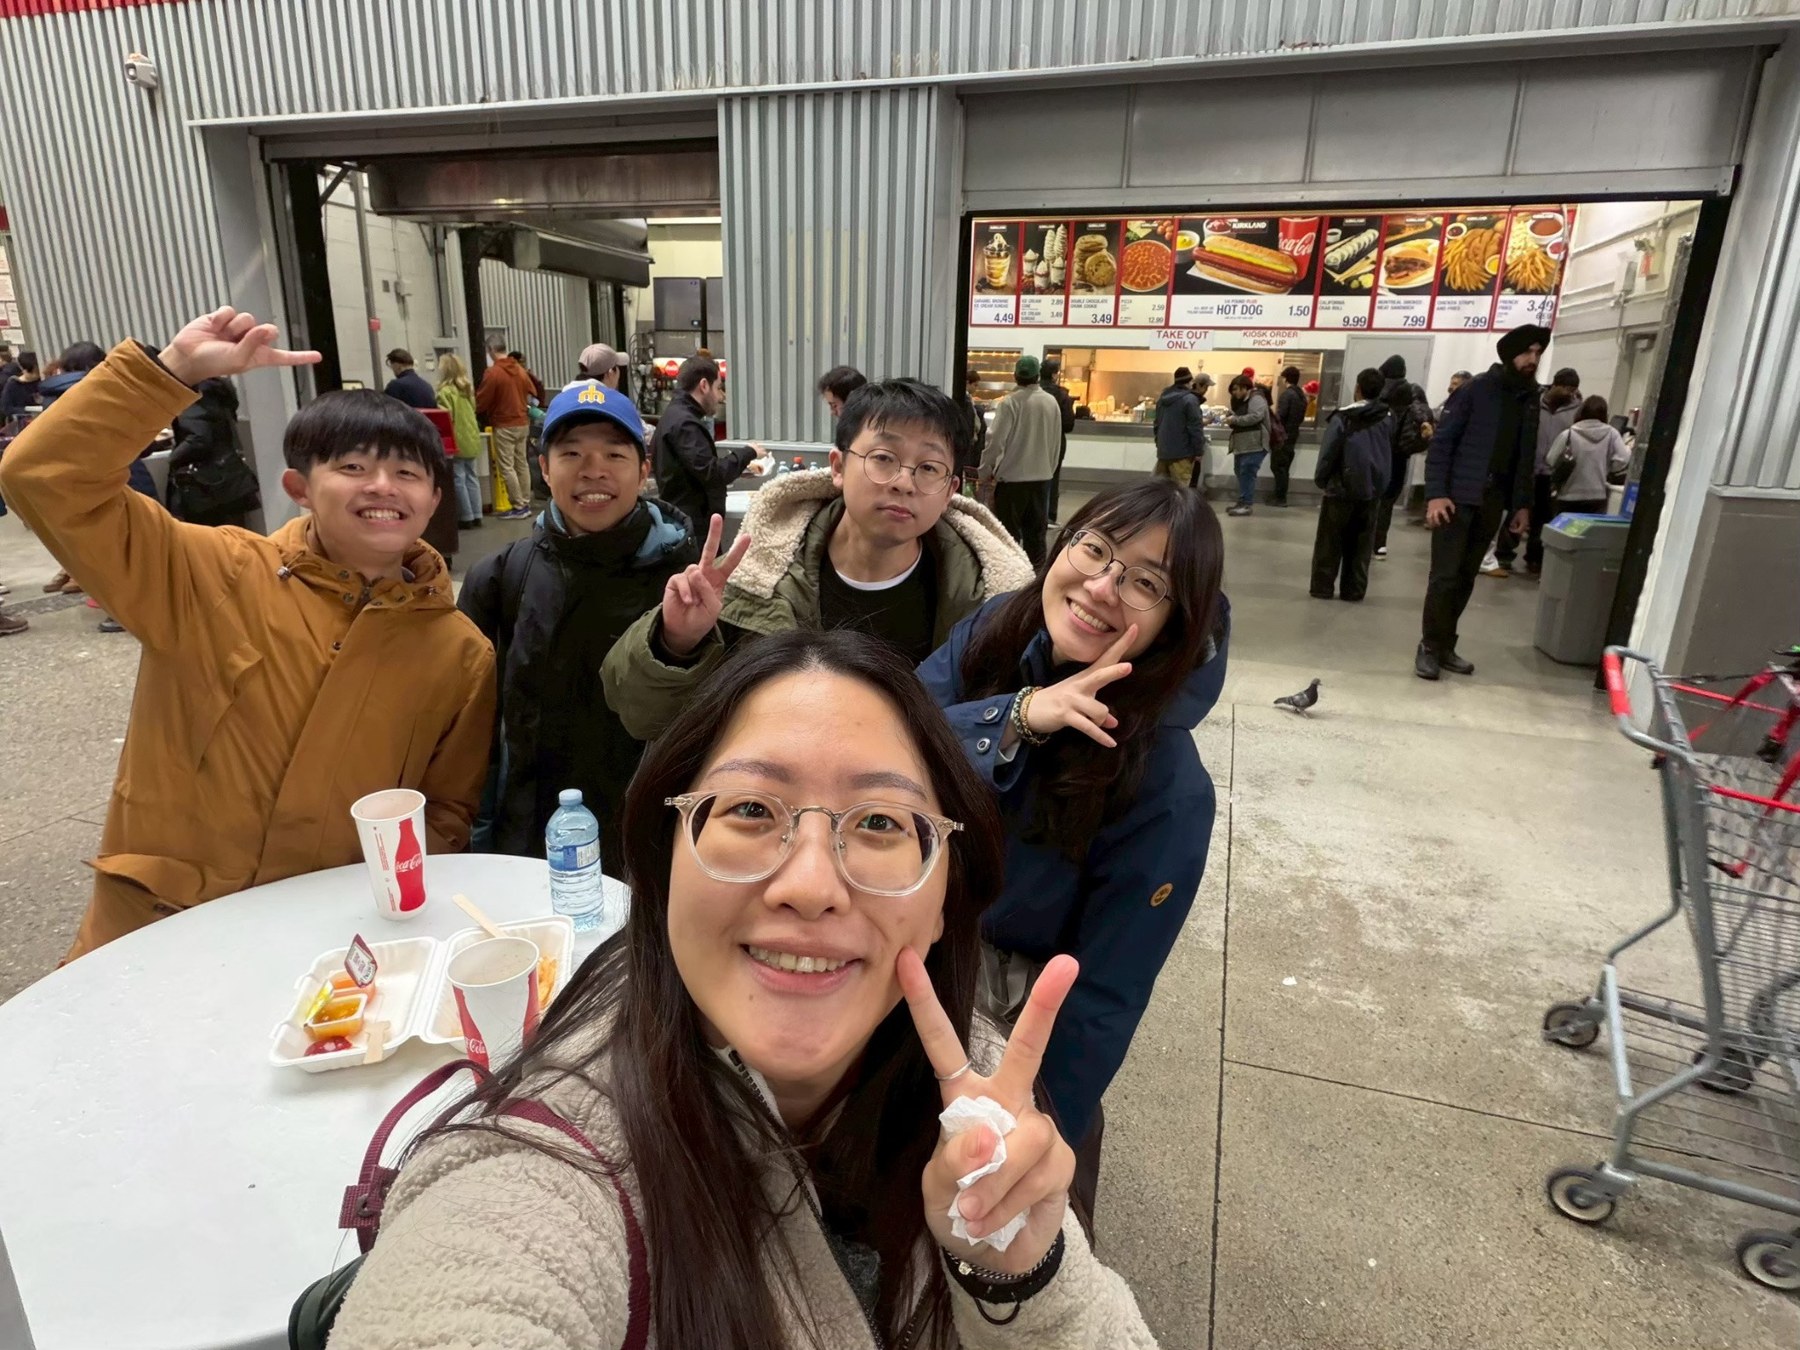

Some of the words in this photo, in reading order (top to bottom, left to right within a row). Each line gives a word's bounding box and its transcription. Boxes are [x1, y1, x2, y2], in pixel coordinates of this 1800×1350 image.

[1231, 221, 1267, 230] KIRKLAND
[1216, 304, 1238, 315] HOT
[1241, 304, 1263, 315] DOG
[1289, 305, 1310, 316] 1.50
[1526, 299, 1554, 312] 3.49
[994, 313, 1014, 323] 4.49
[1091, 313, 1112, 324] 3.49
[1342, 316, 1367, 327] 9.99
[1402, 316, 1426, 327] 7.99
[1464, 316, 1487, 328] 7.99
[1156, 330, 1187, 340] TAKE
[1188, 330, 1209, 340] OUT
[1166, 340, 1196, 350] ONLY
[1252, 339, 1287, 347] PICK-UP
